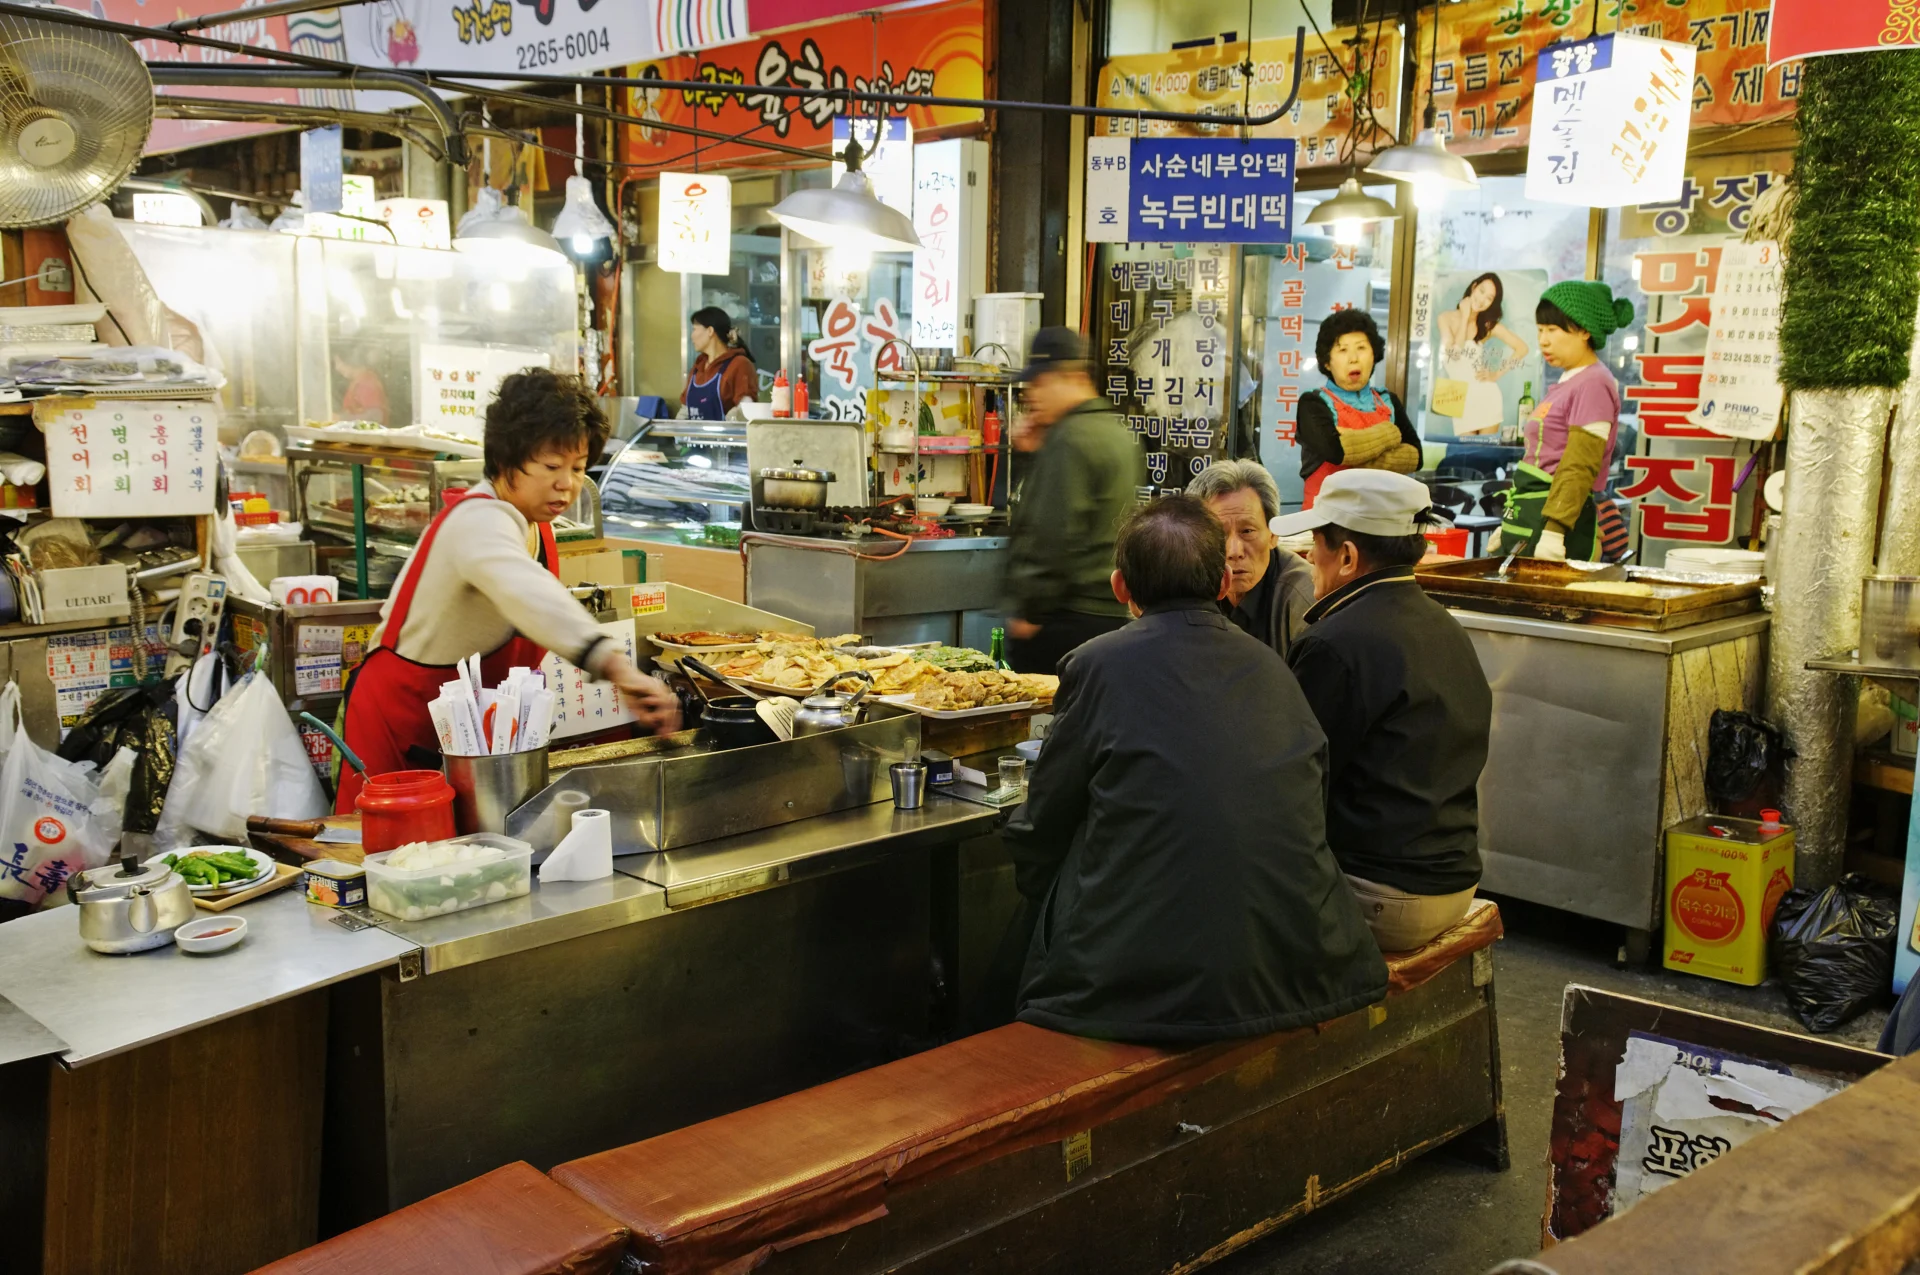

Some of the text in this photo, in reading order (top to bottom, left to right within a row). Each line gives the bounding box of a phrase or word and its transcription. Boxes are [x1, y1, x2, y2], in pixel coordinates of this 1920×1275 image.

[516, 26, 610, 70] 2265-6004
[1552, 42, 1597, 78] 광장
[1110, 75, 1150, 97] 수제비
[1154, 74, 1190, 94] 4,000
[1197, 65, 1241, 91] 해물파전
[1433, 45, 1522, 93] 모듬전
[747, 39, 847, 138] 육회
[1296, 136, 1338, 162] 동주
[1091, 153, 1287, 178] 동부B 사순네부안댁
[1098, 194, 1287, 229] 호 녹두빈대떡
[919, 203, 952, 307] 육회
[1760, 246, 1770, 264] 3
[1111, 257, 1220, 291] 해물빈대떡
[1736, 284, 1742, 293] 2
[1110, 300, 1219, 331] 대구탕
[1414, 292, 1429, 337] 냉방중
[1732, 306, 1738, 316] 9
[1742, 307, 1749, 316] 10
[1752, 307, 1759, 316] 11
[1761, 307, 1768, 316] 12
[1728, 330, 1735, 339] 16
[1738, 330, 1745, 339] 17
[1767, 331, 1776, 340] 20
[1107, 338, 1218, 368] 조개탕
[1723, 352, 1732, 361] 23
[1734, 353, 1742, 362] 24
[1743, 353, 1752, 362] 25
[1753, 354, 1761, 363] 26
[1763, 354, 1771, 363] 27
[1106, 376, 1214, 407] 두부김치
[1719, 375, 1728, 384] 30
[1729, 376, 1737, 385] 31
[1724, 402, 1760, 416] PRIMO
[65, 595, 113, 608] ULTARI
[1721, 849, 1748, 862] 100%
[309, 874, 340, 892] 런천미트
